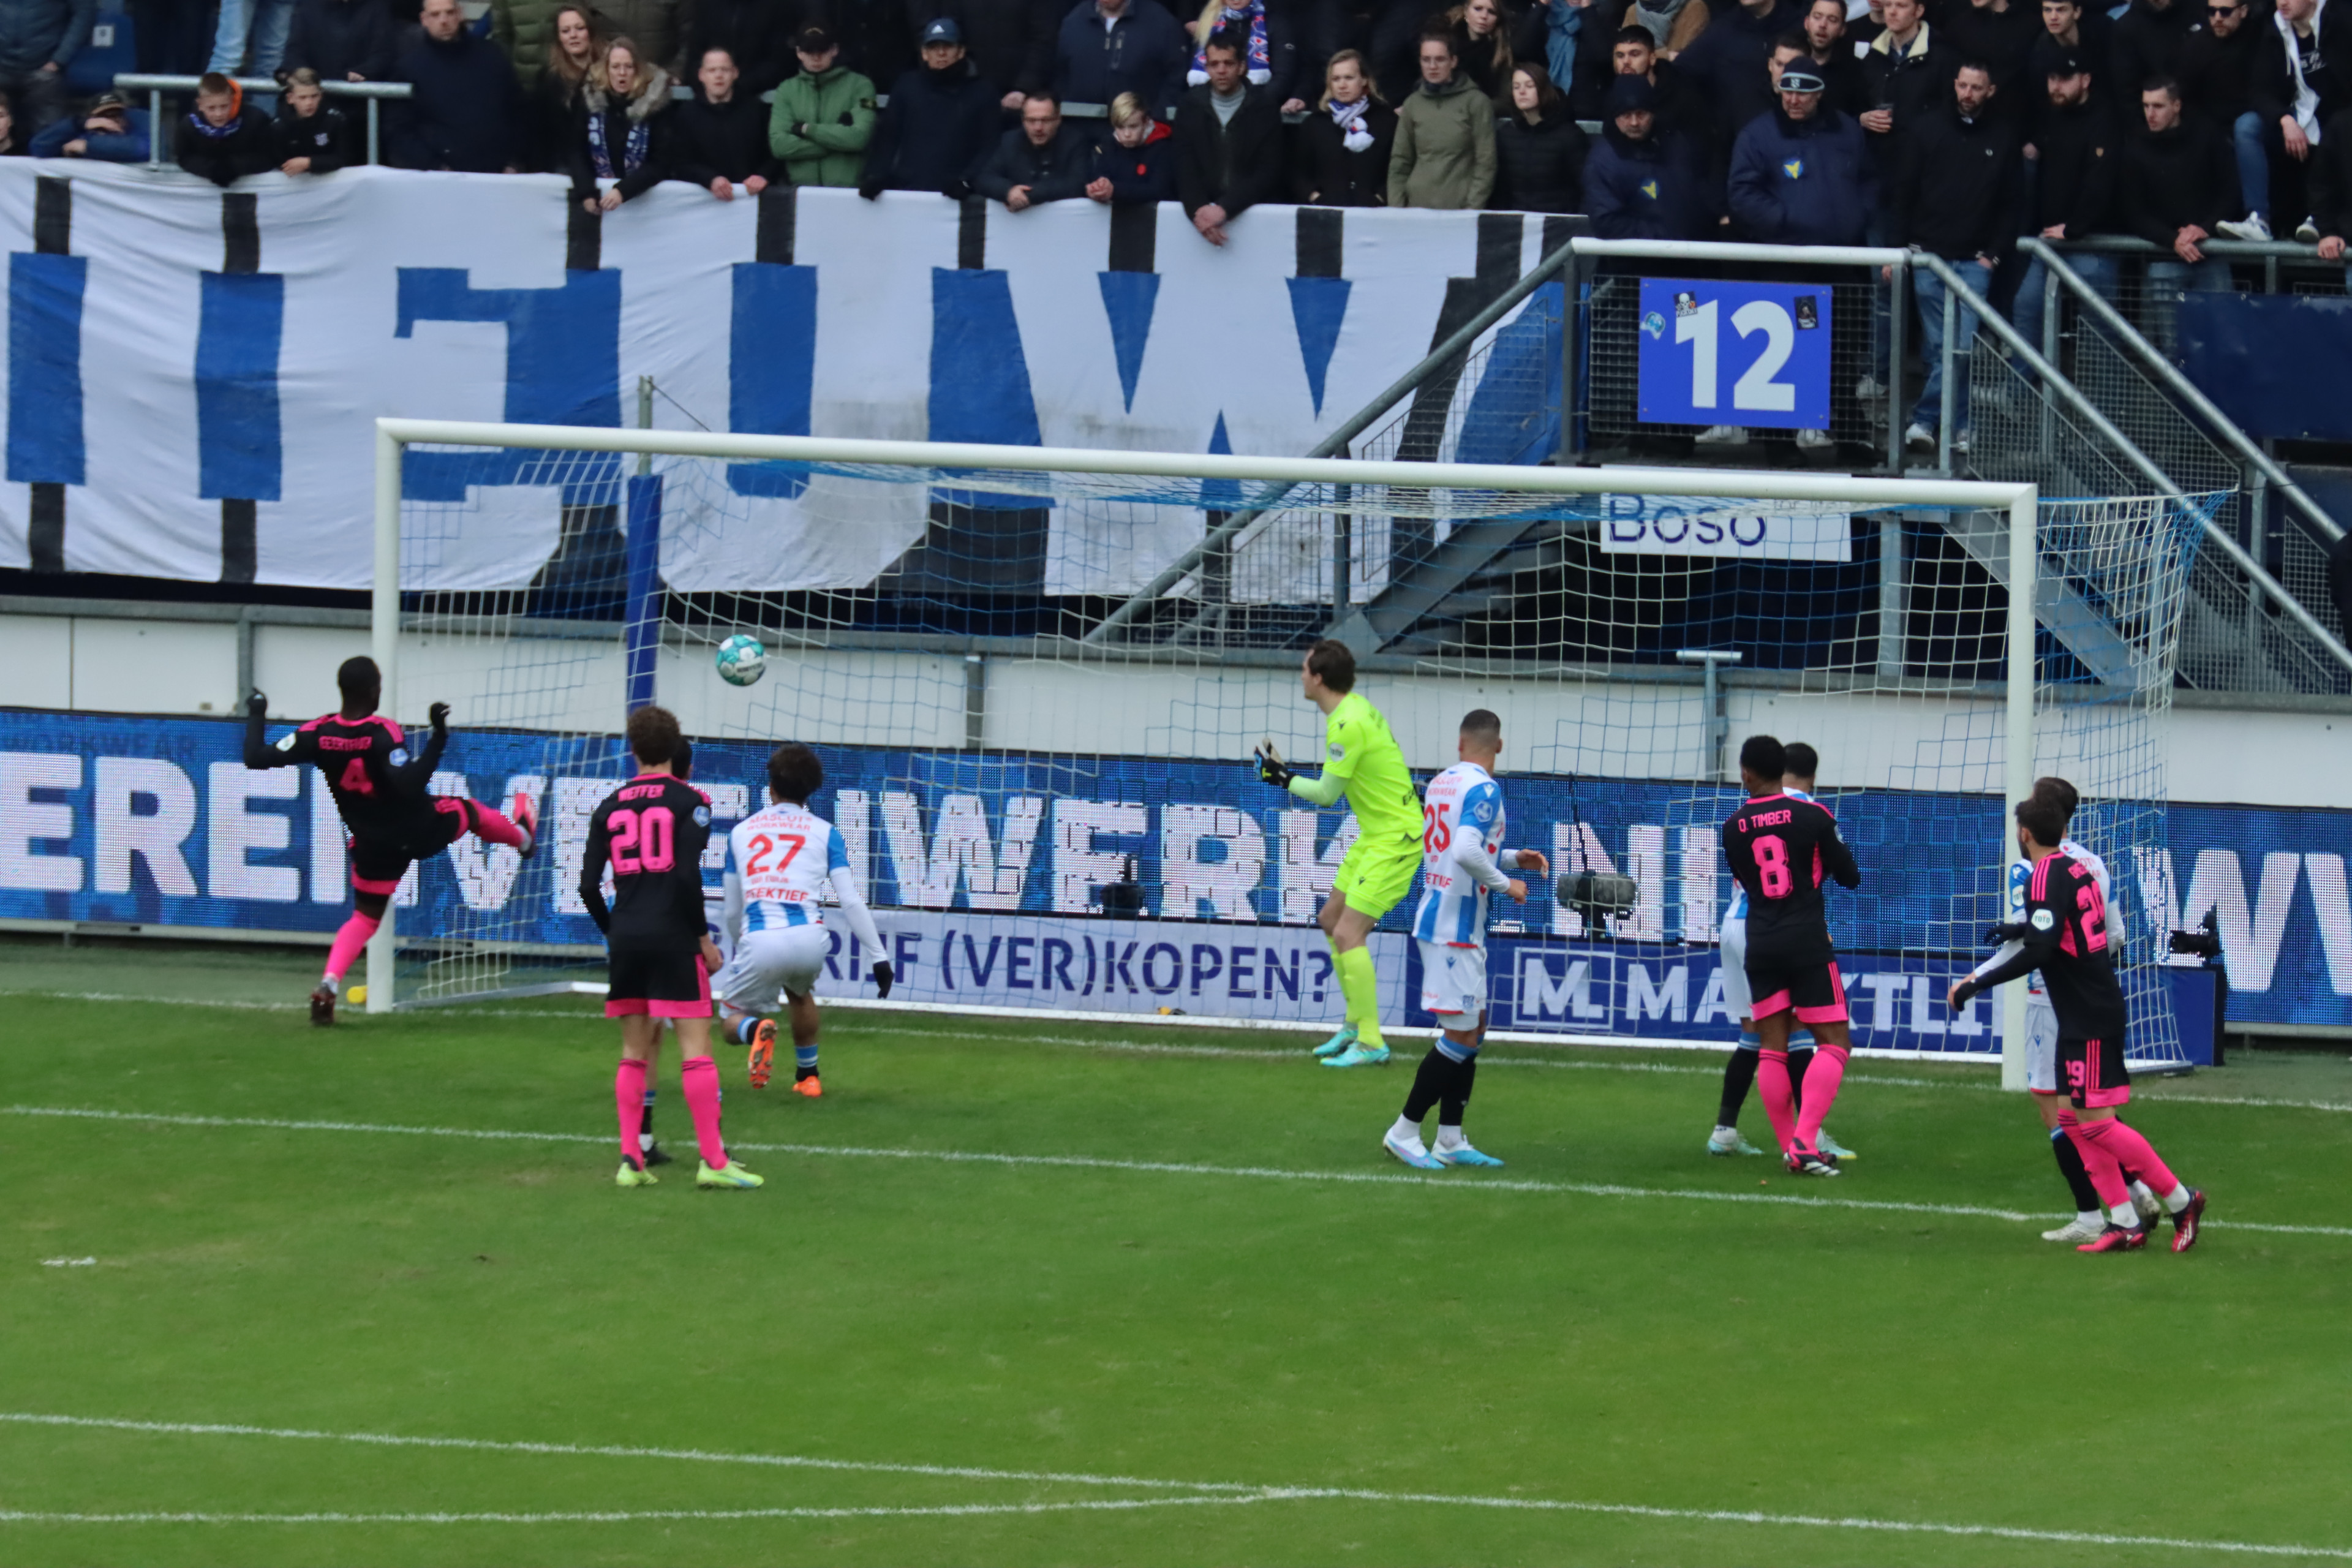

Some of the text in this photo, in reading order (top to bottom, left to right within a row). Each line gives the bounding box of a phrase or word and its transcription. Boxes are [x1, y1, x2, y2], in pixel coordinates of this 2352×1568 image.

[1675, 299, 1795, 412] 12
[339, 757, 374, 794] 4
[606, 805, 676, 875] 20
[1424, 804, 1450, 853] 25
[1751, 809, 1792, 828] TIMBER
[746, 833, 806, 877] 27
[1751, 834, 1793, 900] 8
[2034, 915, 2051, 924] TOTO
[941, 929, 1334, 1003] (VER)KOPEN?
